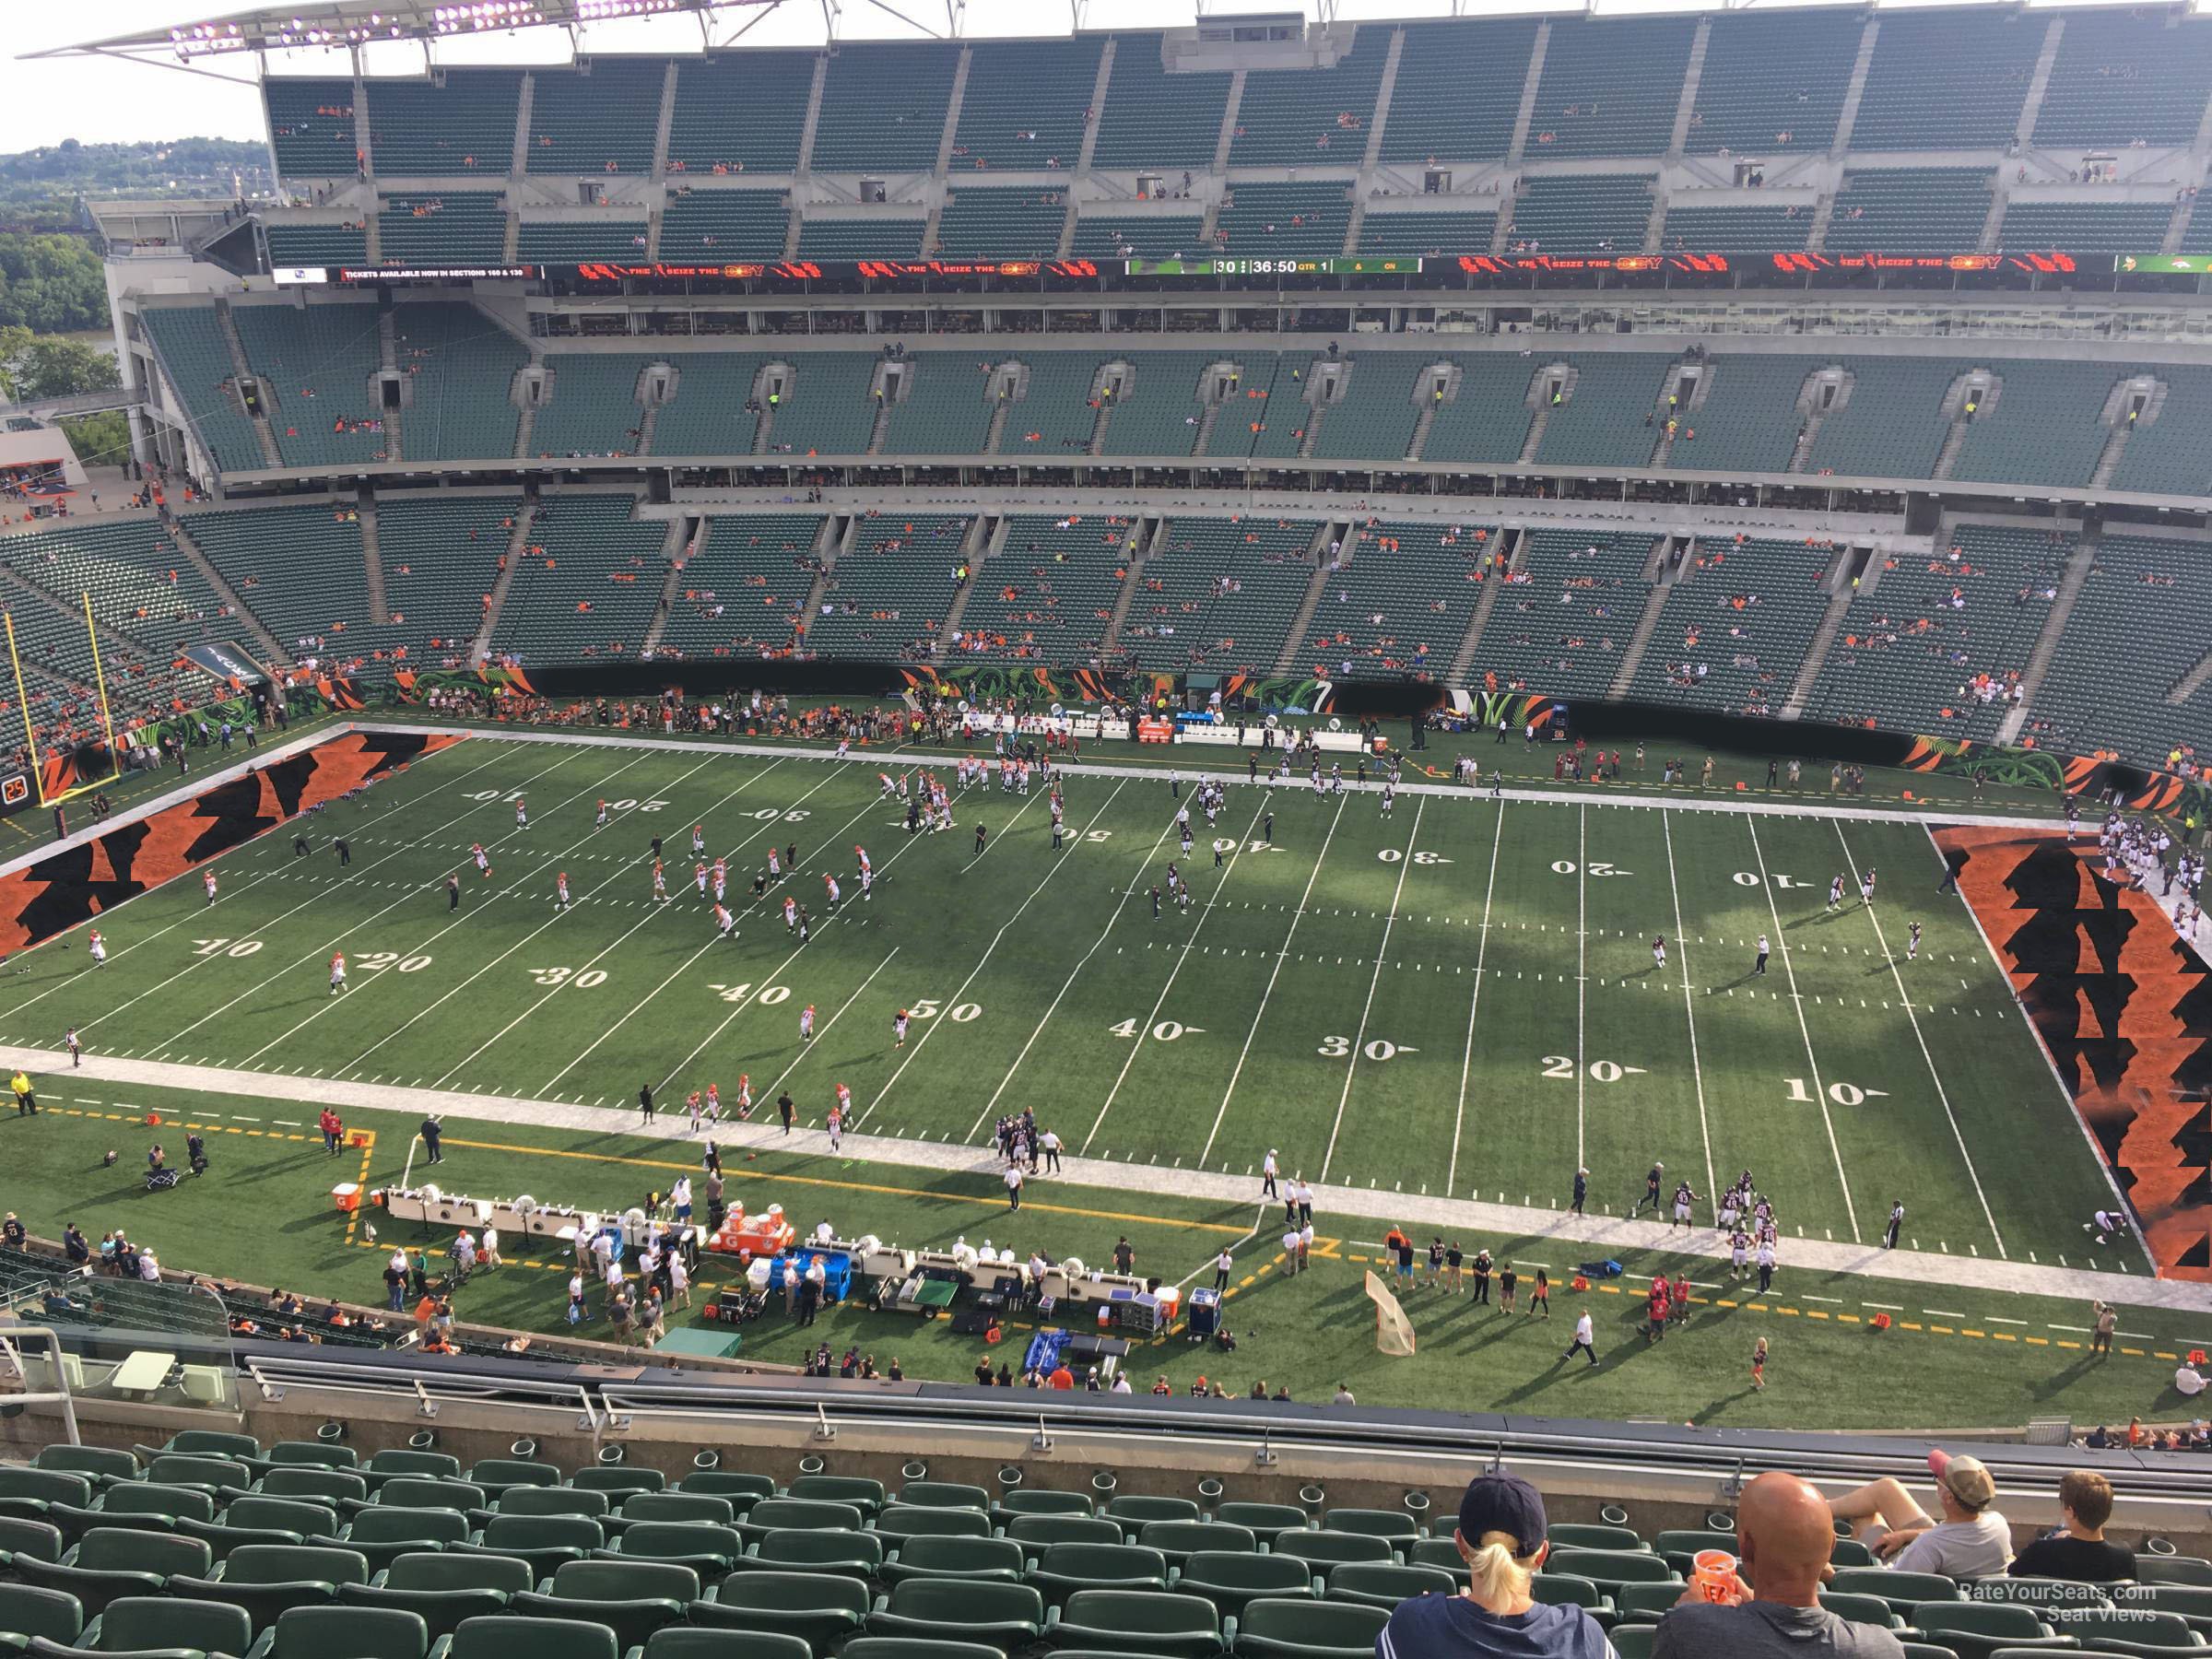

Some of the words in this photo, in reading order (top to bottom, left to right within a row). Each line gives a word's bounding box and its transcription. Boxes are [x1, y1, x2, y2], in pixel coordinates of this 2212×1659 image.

[1253, 261, 1297, 273] 36:50
[6, 780, 25, 800] 25
[612, 798, 671, 812] 20
[754, 808, 812, 822] 30
[1378, 849, 1439, 865] 30
[1551, 861, 1615, 877] 20
[1733, 872, 1796, 888] 10
[192, 937, 264, 958] 10
[356, 952, 432, 972] 20
[535, 967, 608, 988] 30
[719, 982, 792, 1005] 40
[907, 999, 982, 1022] 50
[1109, 1018, 1183, 1041] 40
[1317, 1035, 1395, 1061] 30
[1541, 1055, 1622, 1083] 20
[1783, 1078, 1865, 1106] 10
[725, 1236, 738, 1248] G
[1575, 1277, 1586, 1288] 20
[1877, 1315, 1888, 1325] 10
